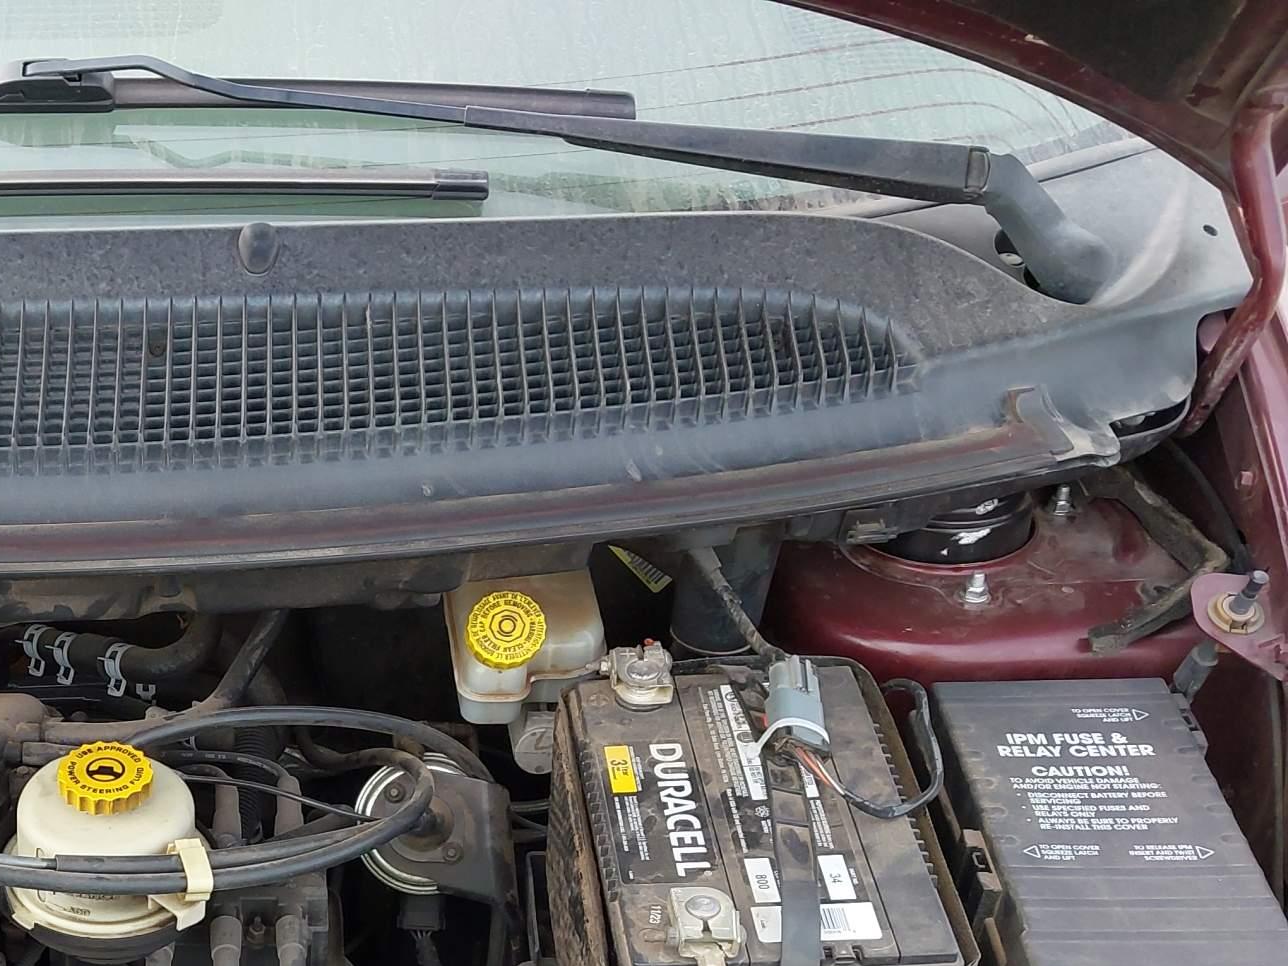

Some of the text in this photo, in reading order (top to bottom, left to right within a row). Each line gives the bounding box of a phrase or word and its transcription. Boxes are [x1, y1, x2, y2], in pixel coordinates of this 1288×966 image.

[481, 601, 502, 618] BEFORE
[504, 600, 534, 618] REMOVING
[1006, 733, 1128, 745] IPM FUSE &
[76, 745, 142, 763] USE APPROVED
[996, 744, 1156, 758] RELAY CENTER
[610, 759, 627, 767] 3
[68, 761, 144, 794] POWER STEERING FLUID
[1031, 766, 1130, 777] CAUTION!
[648, 742, 712, 878] DURACELL
[1032, 804, 1050, 812] USE
[1052, 804, 1098, 812] SPECIFIED
[1099, 804, 1126, 812] FUSES
[754, 874, 770, 890] 800
[828, 872, 843, 884] 34
[646, 904, 662, 925] 11/23
